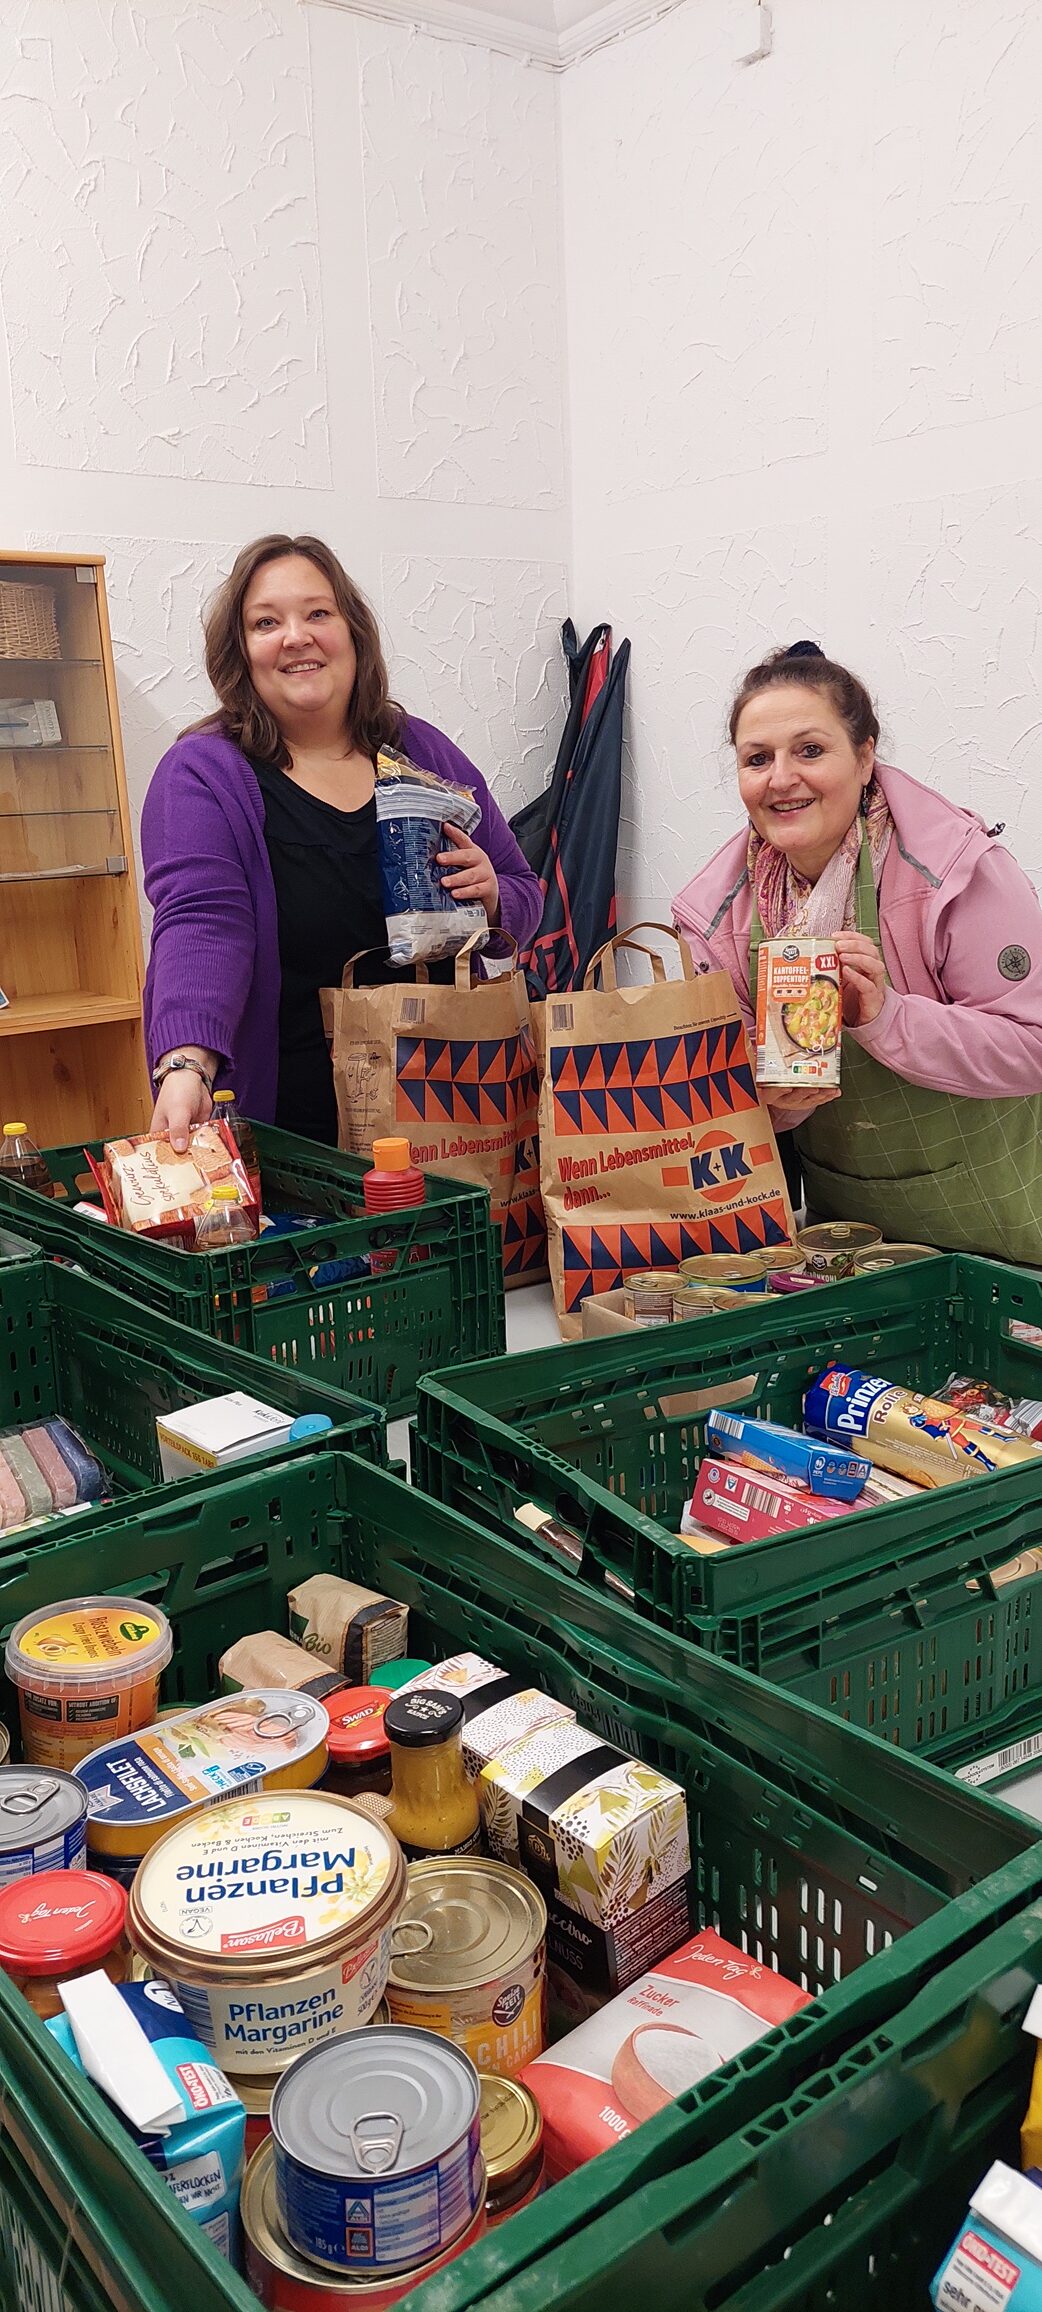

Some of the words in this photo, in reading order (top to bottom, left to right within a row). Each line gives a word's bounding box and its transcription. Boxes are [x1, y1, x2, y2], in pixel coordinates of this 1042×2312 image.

[820, 956, 836, 969] XXL
[409, 1142, 438, 1165] enn
[558, 1156, 597, 1182] Wenn
[599, 1132, 696, 1172] Lebensmittel,
[690, 1142, 753, 1190] K+K
[670, 1189, 781, 1220] www.klaas-und-kock.de
[873, 1390, 908, 1424] Rolle
[304, 1632, 332, 1655] Bio
[106, 1758, 167, 1812] LACHSFILET
[191, 1840, 221, 1848] Backen
[241, 1841, 290, 1850] Vitaminen
[271, 1830, 319, 1839] Streichen,
[176, 1847, 356, 1881] Margarine
[186, 1873, 344, 1904] Pflanzen
[181, 1907, 211, 1915] VEGAN
[228, 1920, 305, 1947] Bellasan
[673, 1945, 724, 1966] Jeden
[722, 1960, 748, 1981] Tag
[229, 1988, 336, 2021] Pflanzen
[505, 1994, 520, 2010] ZEIT
[627, 1996, 664, 2017] Raffinade
[639, 1984, 680, 2008] Zucker
[224, 2003, 344, 2045] Margarine
[266, 2042, 306, 2054] Vitaminen
[478, 2010, 537, 2066] CHILI
[599, 2105, 626, 2132] 1000
